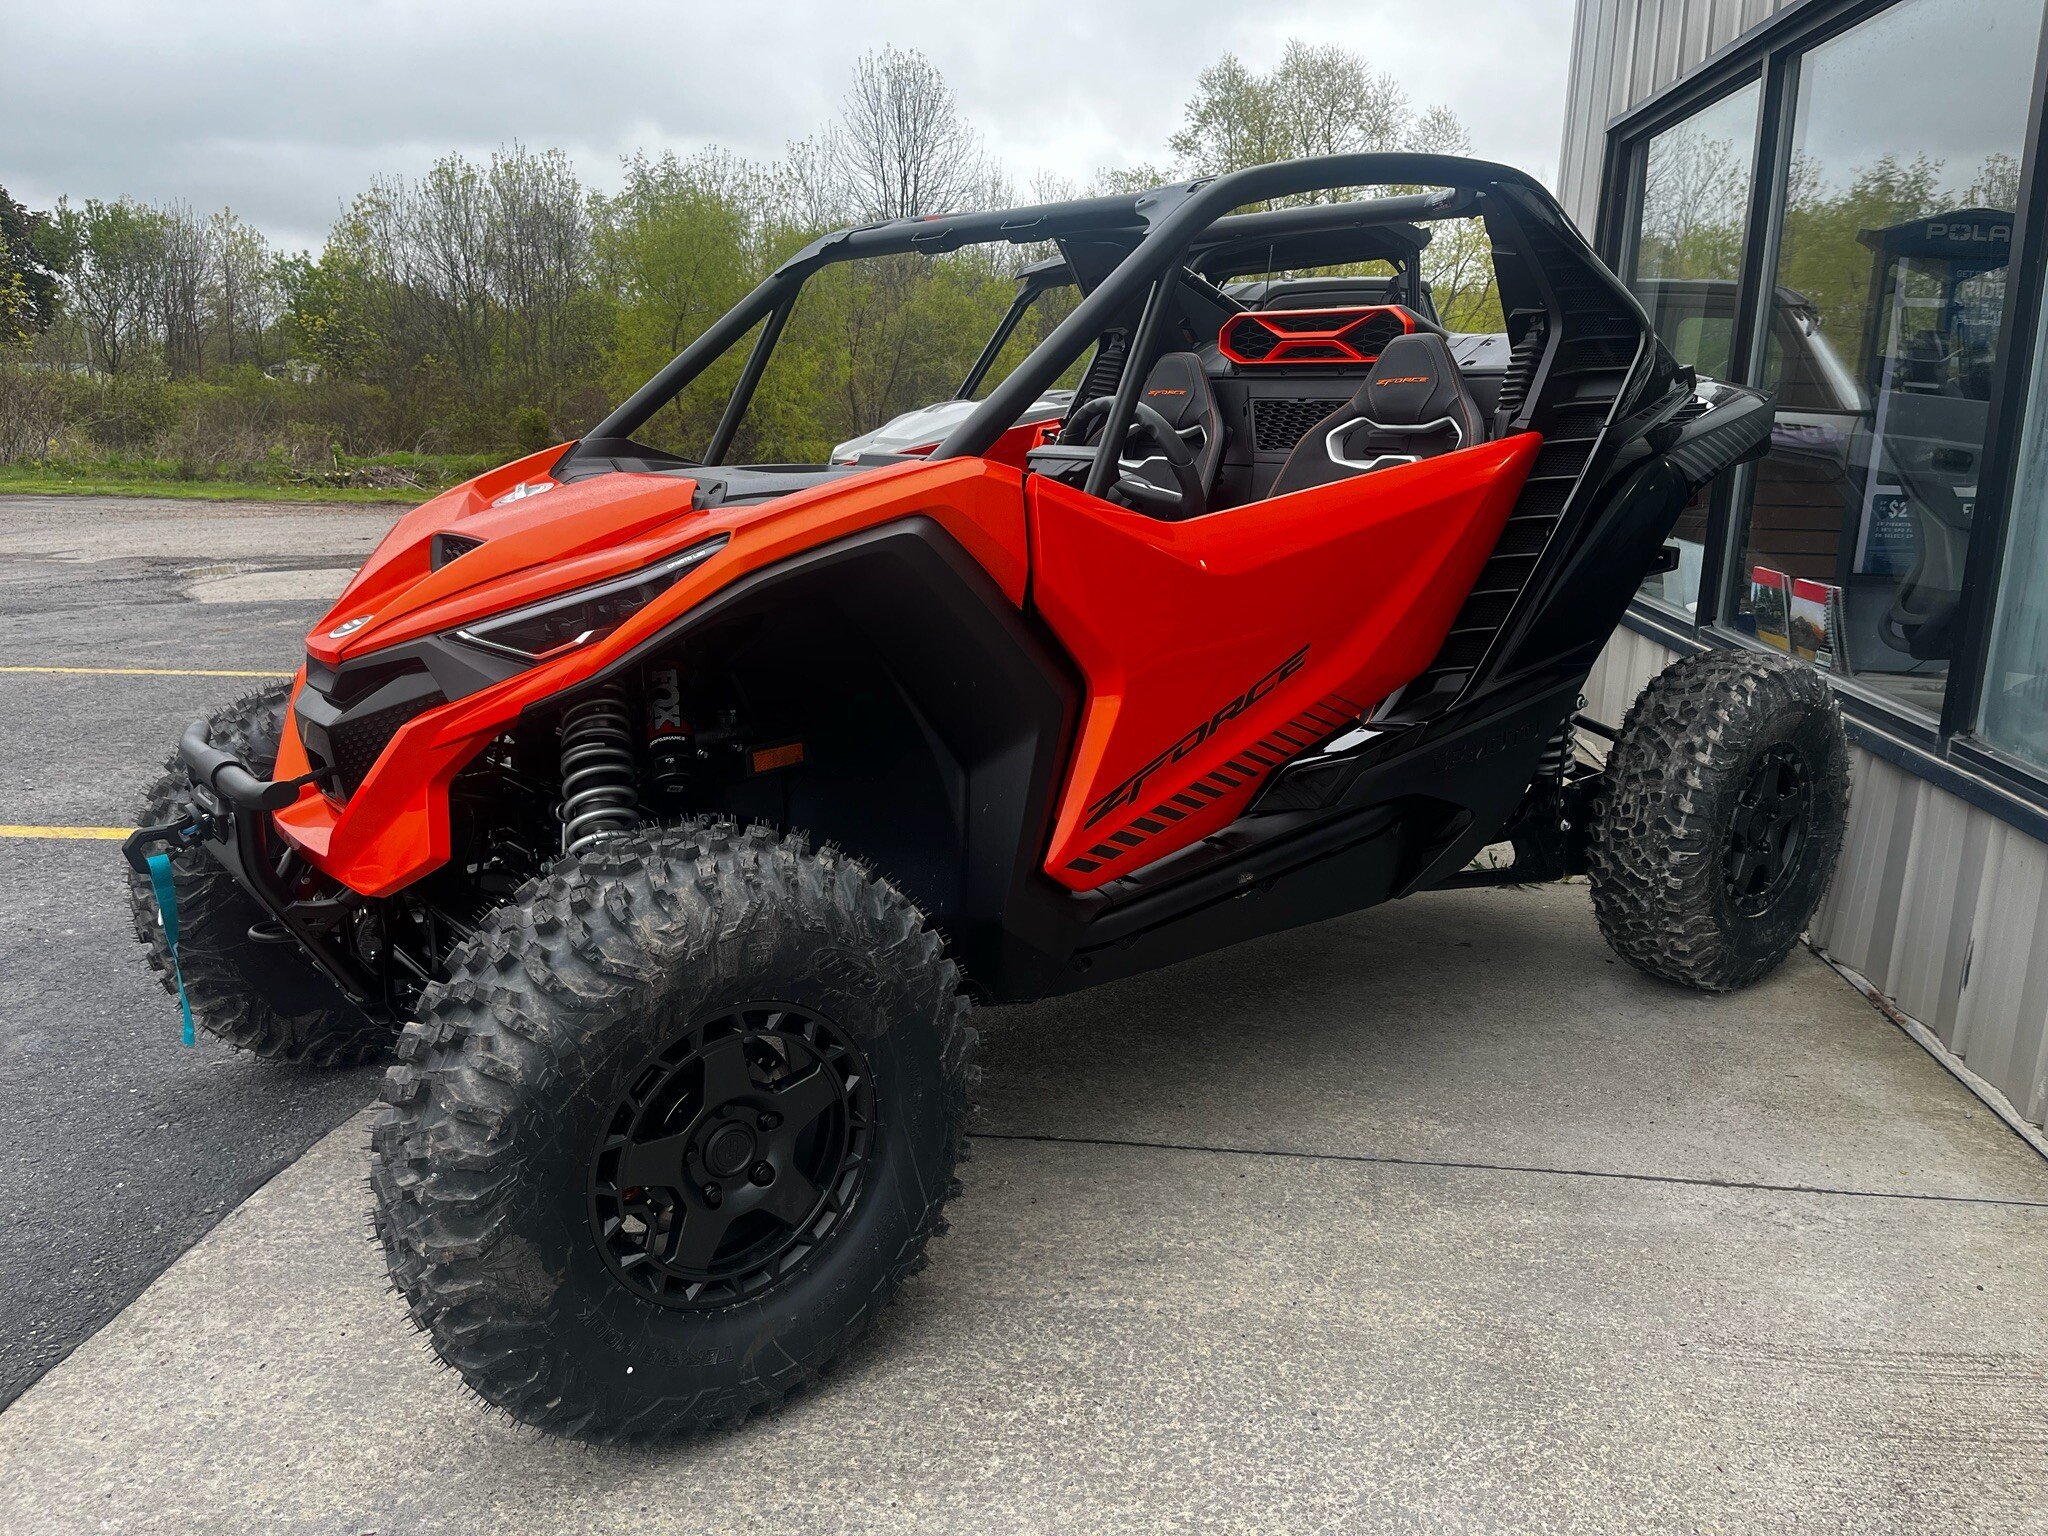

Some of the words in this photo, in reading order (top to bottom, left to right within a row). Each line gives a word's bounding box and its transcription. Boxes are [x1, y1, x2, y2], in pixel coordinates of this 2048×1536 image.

[1375, 376, 1430, 388] ZFORCE
[1147, 389, 1188, 397] ZFORCE
[666, 555, 692, 569] CFMOTO
[649, 668, 681, 730] FOX
[1082, 642, 1312, 832] ZFORCE
